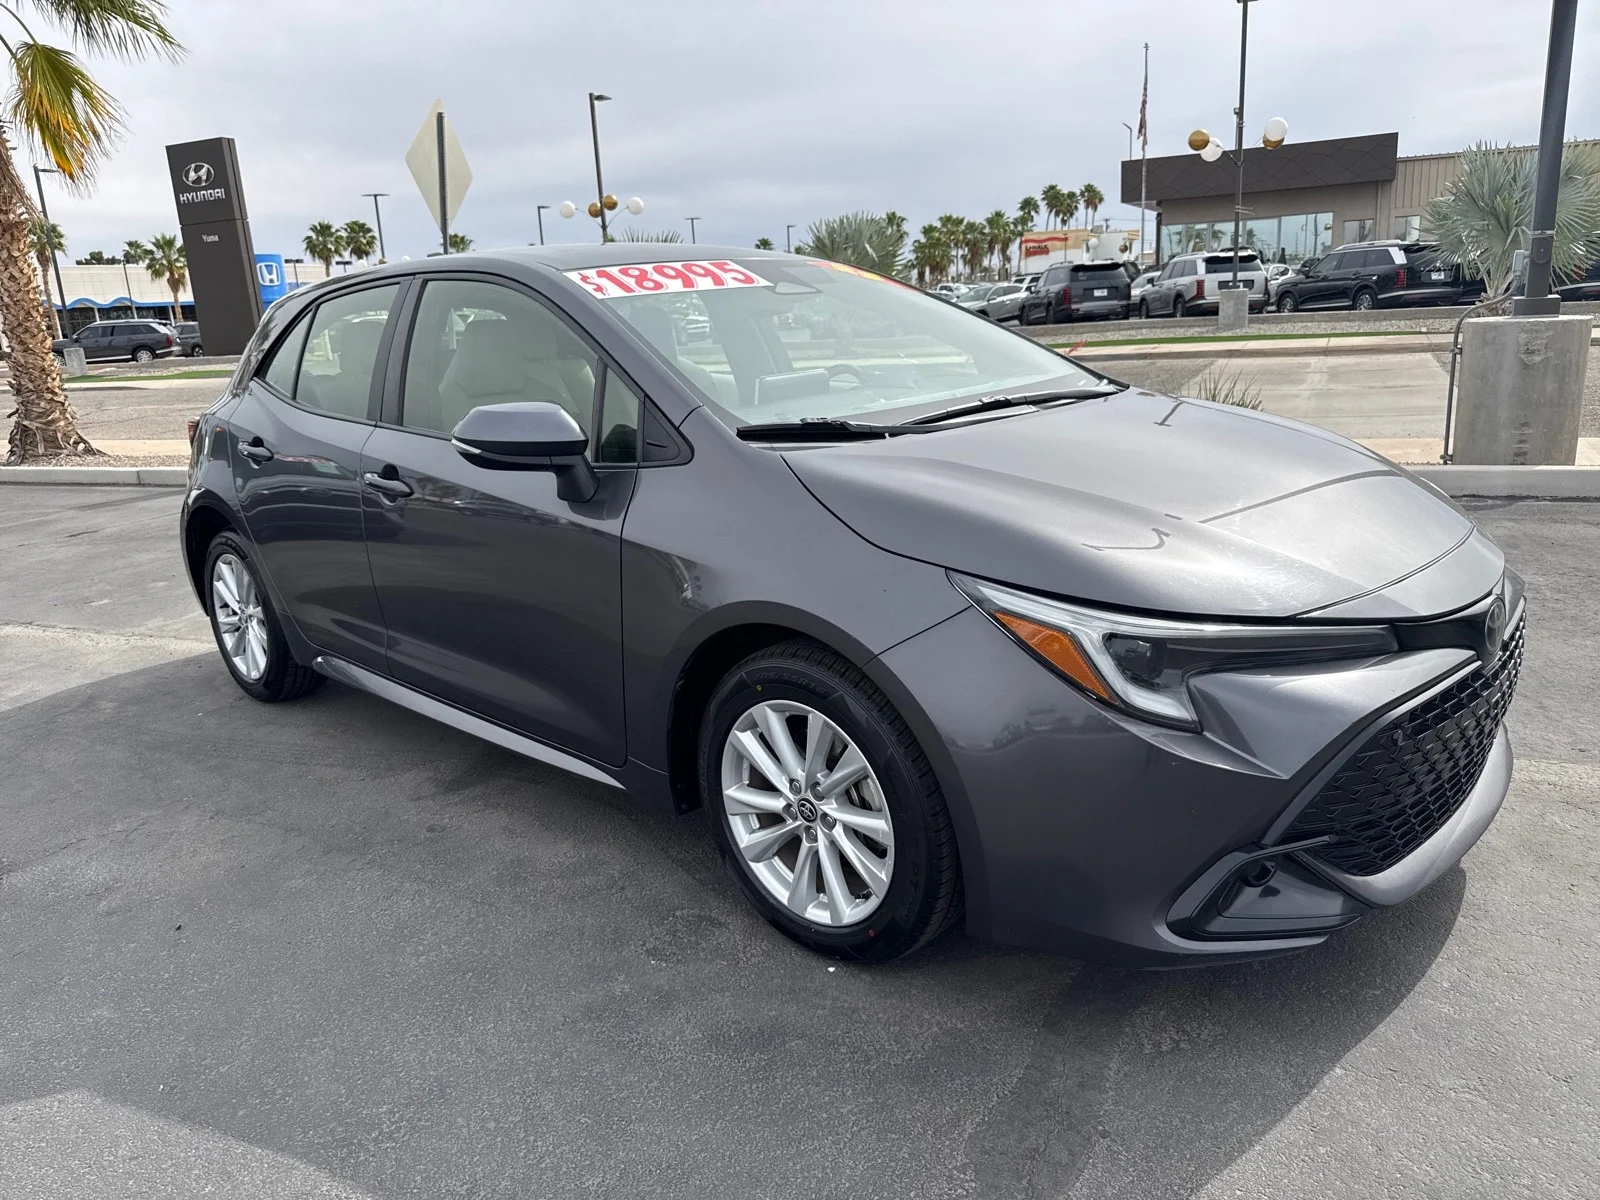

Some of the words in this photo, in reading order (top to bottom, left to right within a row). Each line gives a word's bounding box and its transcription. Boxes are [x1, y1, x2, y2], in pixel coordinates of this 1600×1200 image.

[180, 188, 226, 204] HYUNDAI
[202, 234, 219, 243] Yuma
[577, 262, 758, 296] $18995
